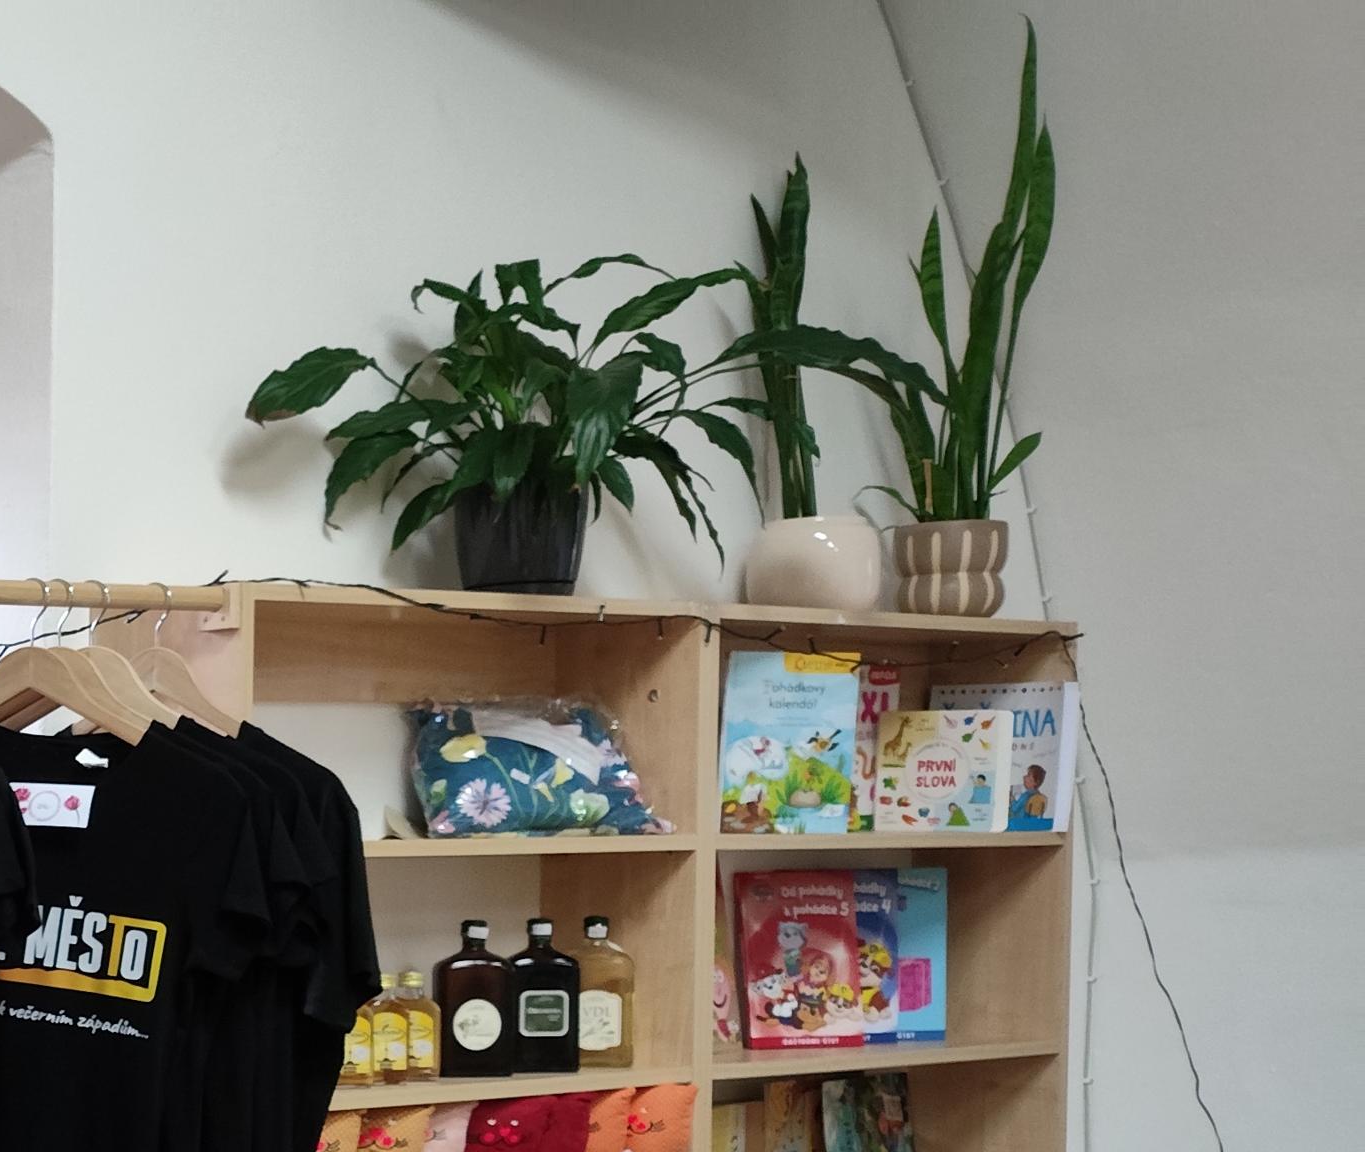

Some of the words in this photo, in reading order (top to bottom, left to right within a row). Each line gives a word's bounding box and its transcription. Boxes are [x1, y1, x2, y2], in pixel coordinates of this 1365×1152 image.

[917, 758, 957, 772] PRVNÍ
[916, 776, 957, 788] SLOVA
[23, 895, 153, 981] MĚSTO
[9, 1005, 74, 1026] večerním
